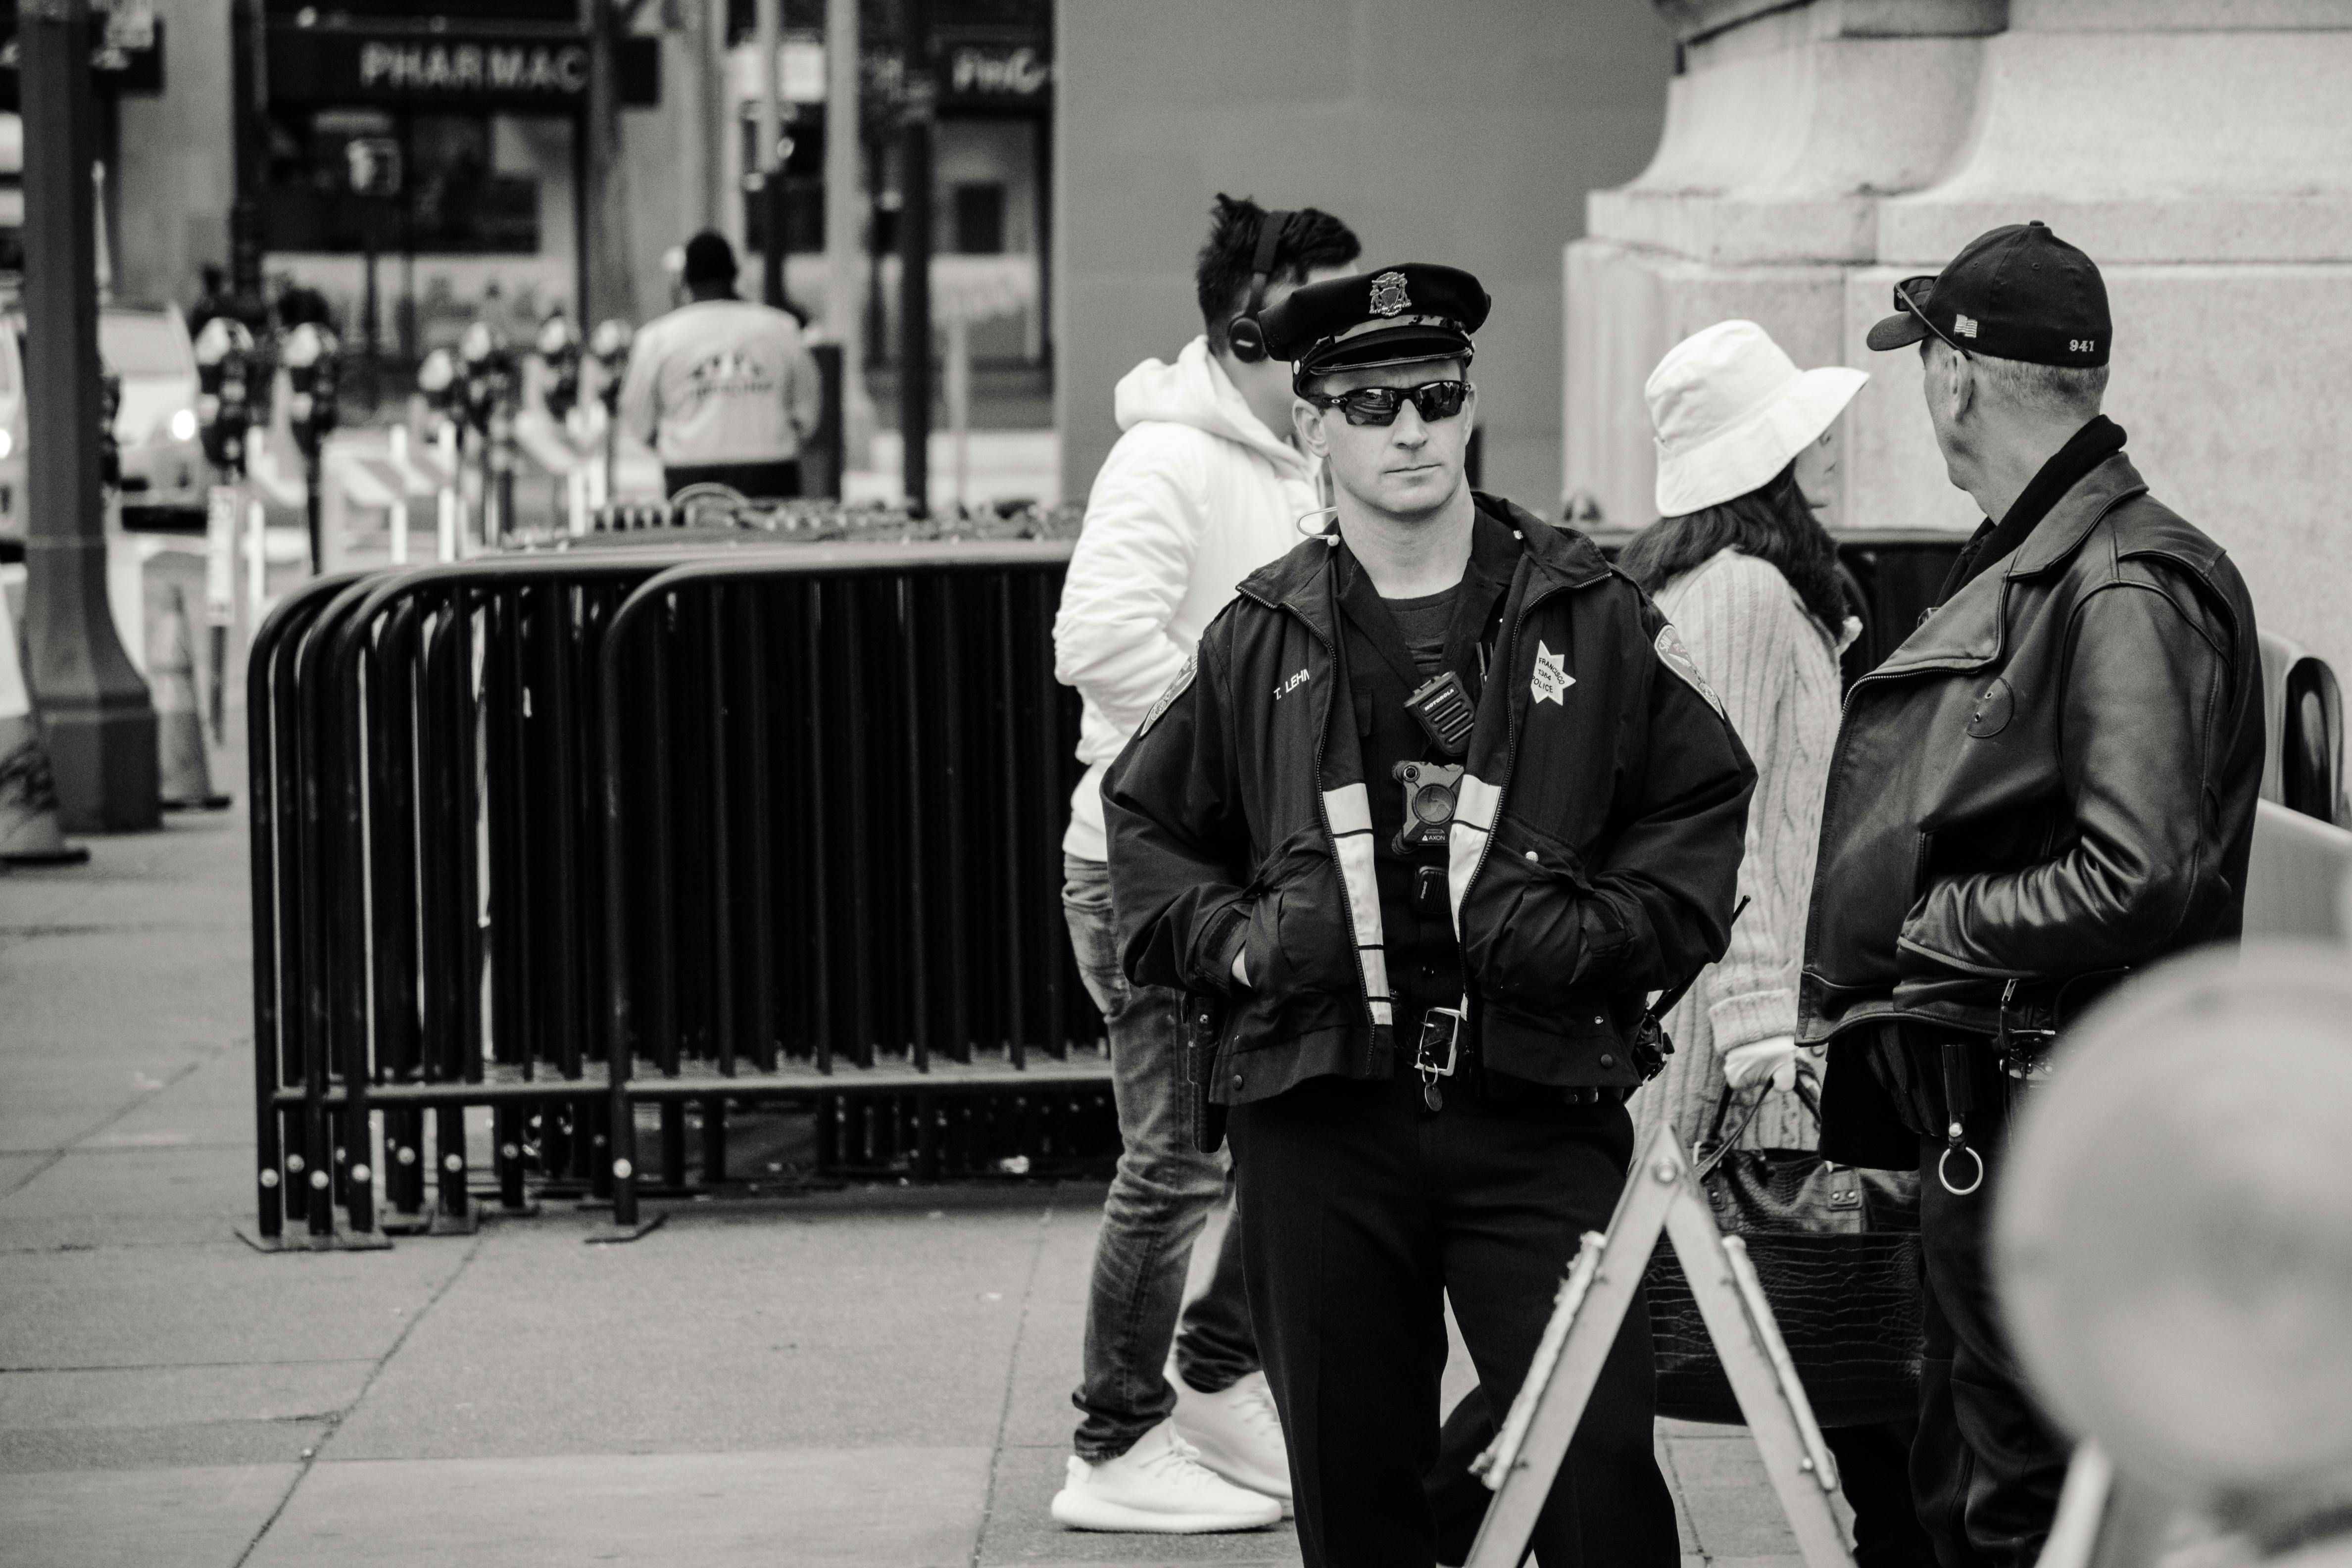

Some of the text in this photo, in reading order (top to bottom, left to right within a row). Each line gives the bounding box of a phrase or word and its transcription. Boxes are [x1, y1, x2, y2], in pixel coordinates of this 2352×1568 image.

[360, 41, 587, 93] PHARMAC
[2069, 340, 2095, 352] 941
[1538, 657, 1565, 685] FRANCISCO
[1273, 687, 1281, 700] T.
[1532, 675, 1553, 693] POLICE
[1424, 688, 1454, 711] MOTOROLA
